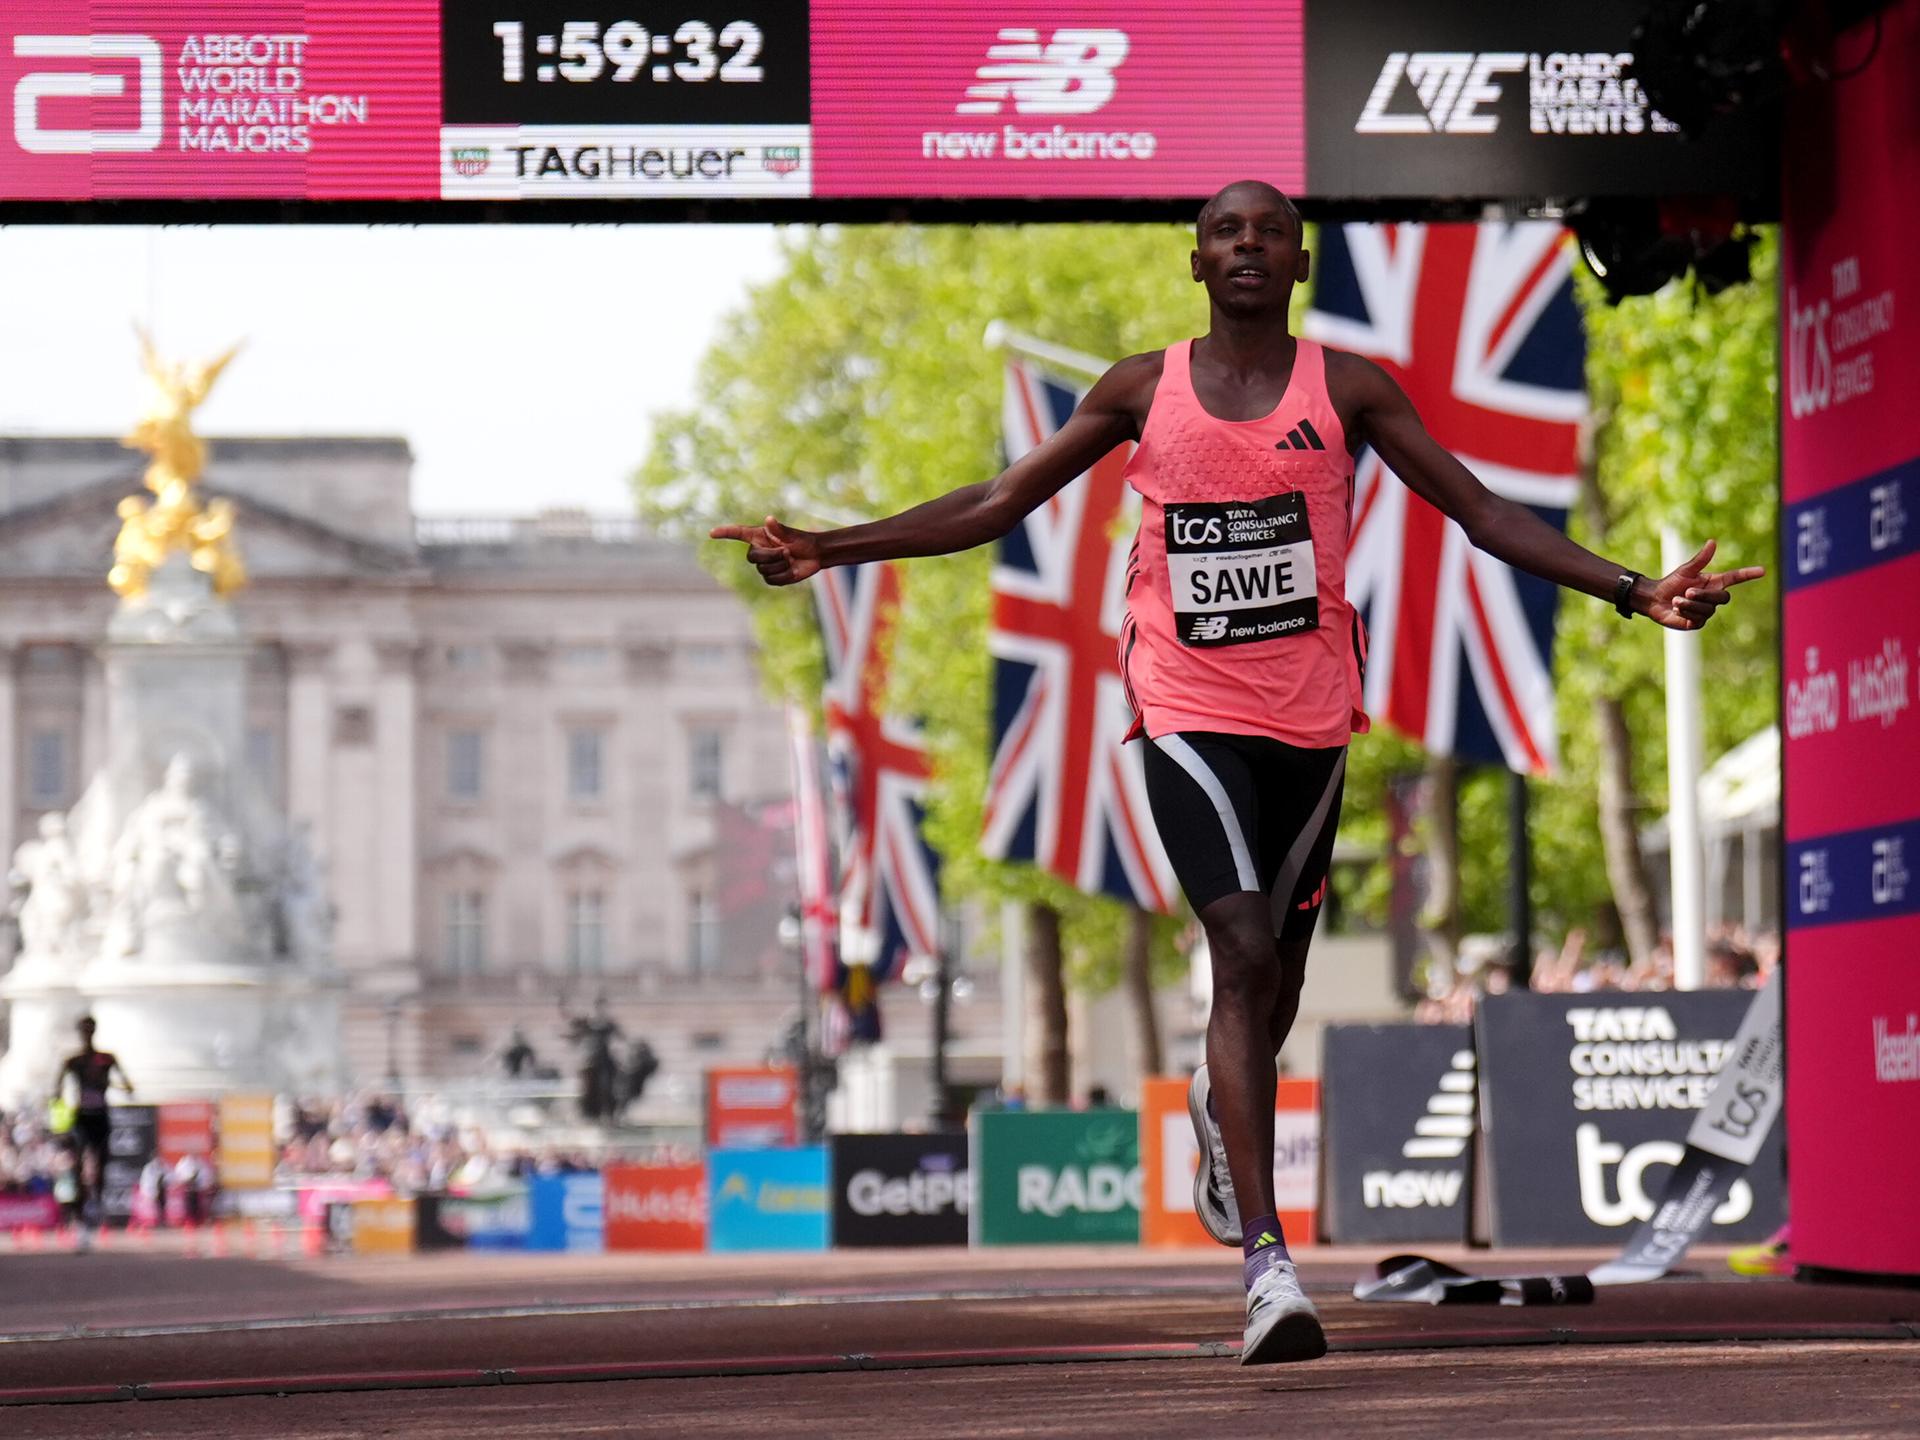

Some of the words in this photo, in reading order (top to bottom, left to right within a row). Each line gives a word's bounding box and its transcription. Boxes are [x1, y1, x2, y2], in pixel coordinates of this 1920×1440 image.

[178, 34, 310, 64] ABBOTT
[493, 20, 764, 82] 1:59:32
[177, 66, 302, 93] WORLD
[178, 95, 367, 124] MARATHON
[178, 124, 312, 153] MAJORS
[922, 132, 998, 158] new
[1003, 125, 1157, 159] balance
[1172, 512, 1222, 545] tcs
[1225, 510, 1257, 519] TATA
[1227, 512, 1299, 532] CONSULTANCY
[1228, 529, 1276, 543] SERVICES
[1190, 561, 1295, 605] SAWE
[1230, 626, 1257, 638] new
[1257, 616, 1306, 635] balance
[1566, 1007, 1678, 1041] TATA
[1710, 1081, 1767, 1139] tcs
[1362, 1169, 1463, 1209] new
